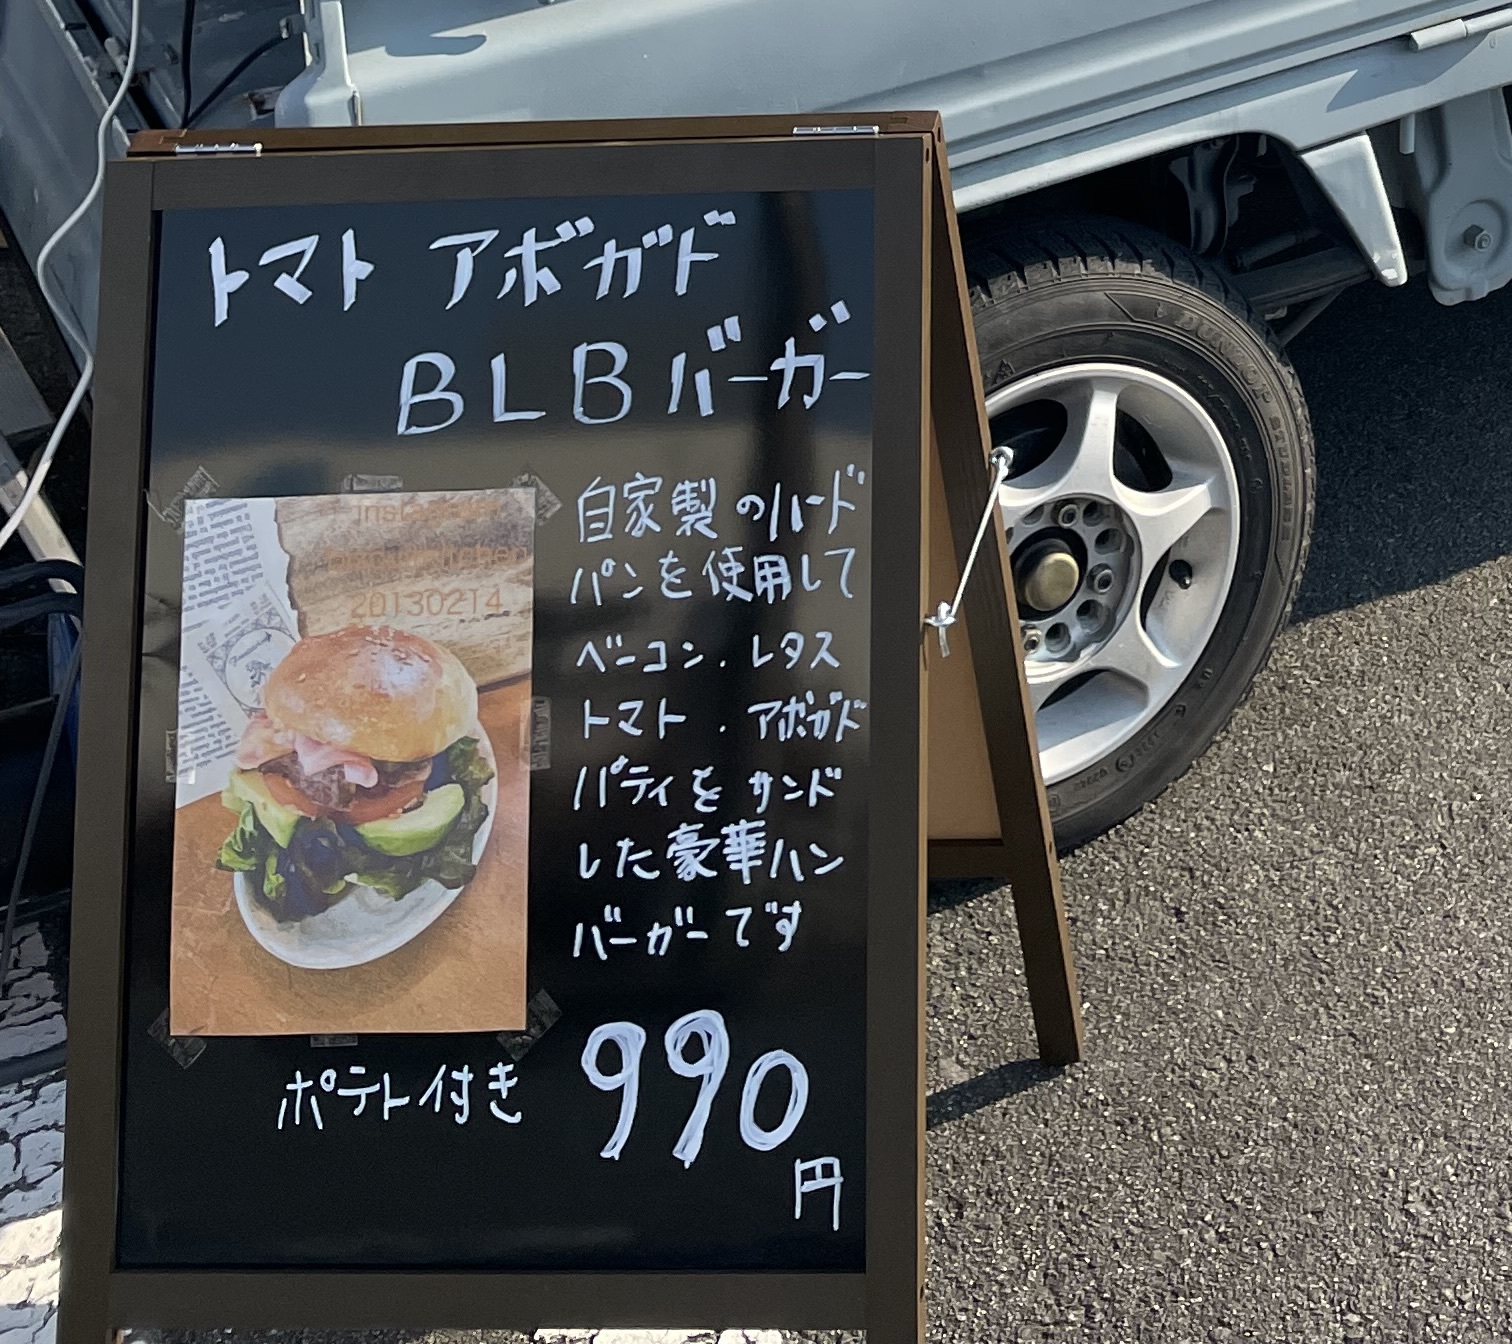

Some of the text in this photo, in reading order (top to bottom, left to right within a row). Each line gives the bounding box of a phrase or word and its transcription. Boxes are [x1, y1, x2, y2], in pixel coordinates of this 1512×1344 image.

[208, 209, 738, 327] トマト アボガド
[351, 587, 504, 619] 20130214
[570, 545, 856, 605] パンを使用して
[579, 819, 845, 885] した豪華ハン
[277, 1062, 523, 1132] ポテト付き
